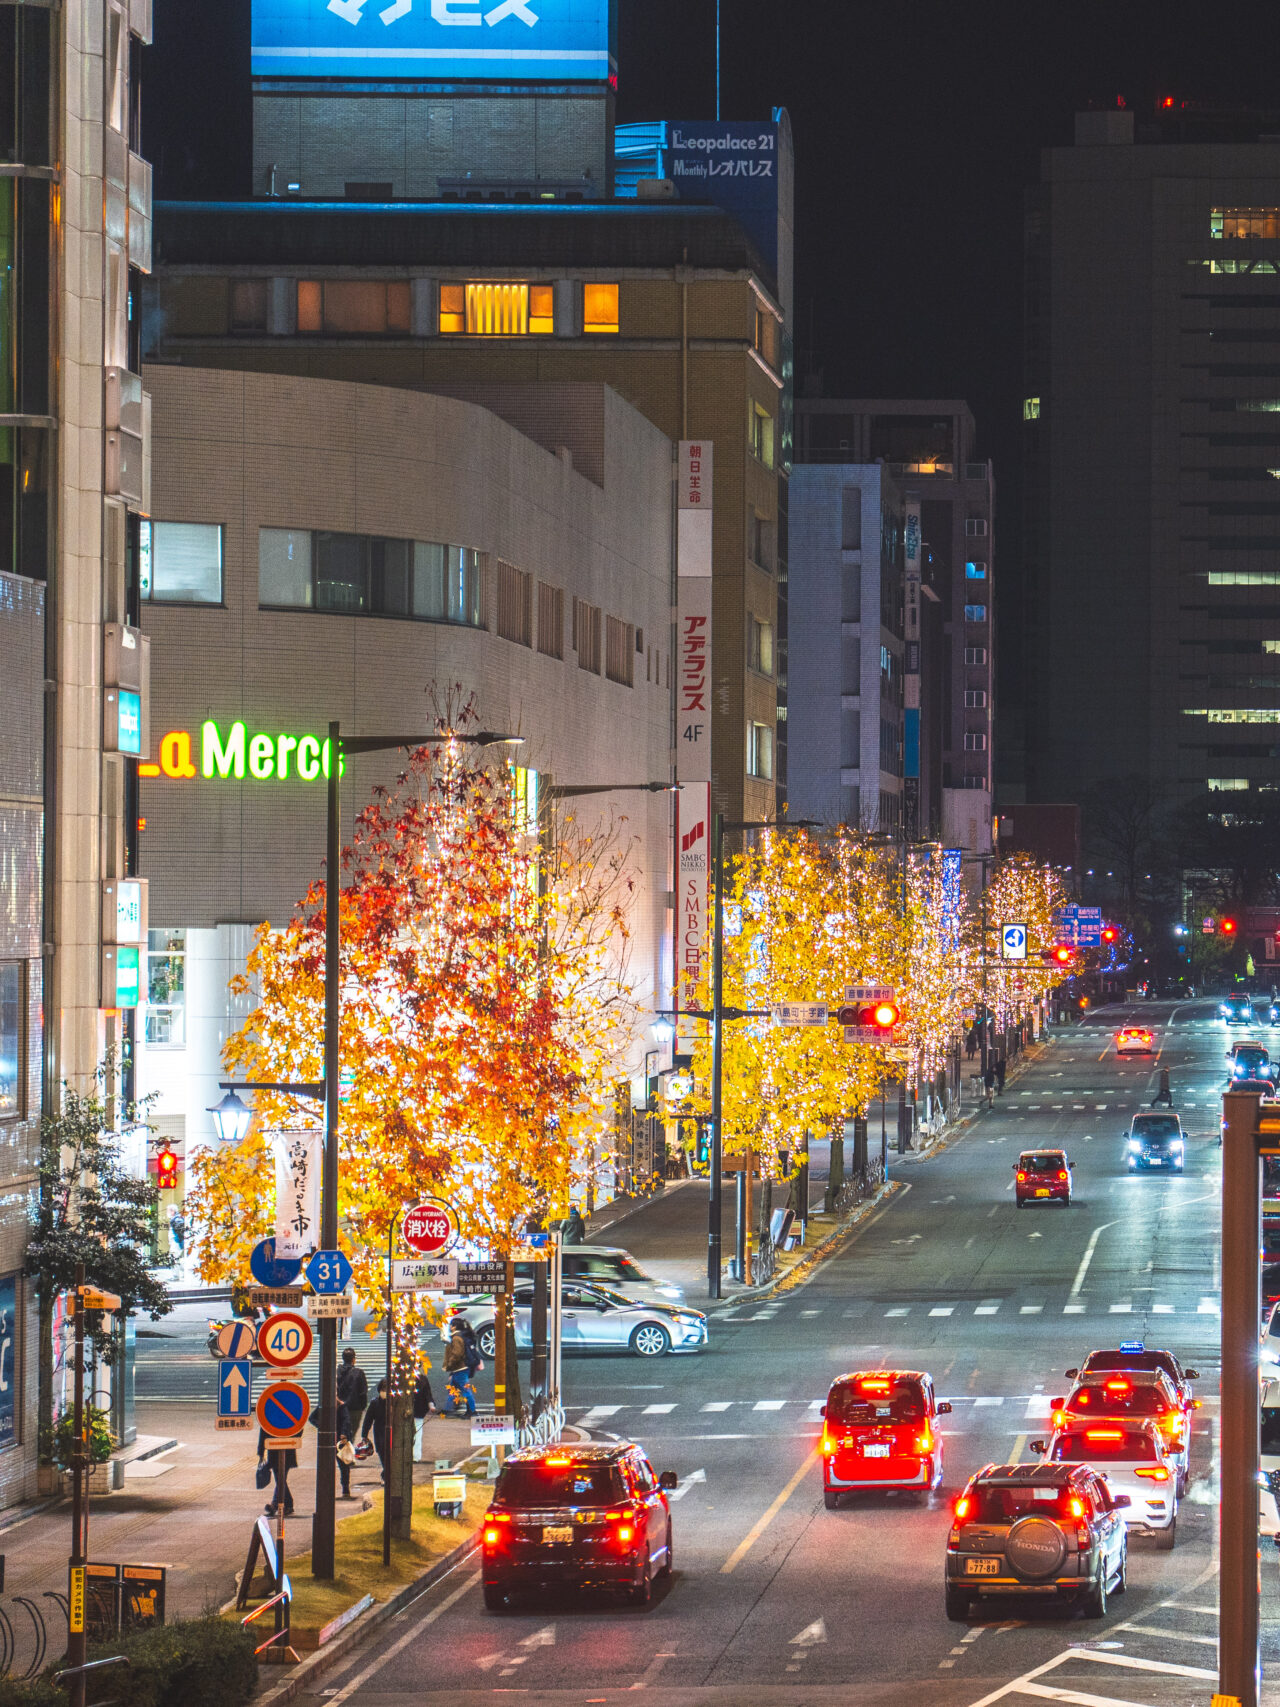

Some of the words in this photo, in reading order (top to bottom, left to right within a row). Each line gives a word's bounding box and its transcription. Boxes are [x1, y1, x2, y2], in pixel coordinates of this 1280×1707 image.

[672, 130, 757, 154] Leopalace
[758, 135, 774, 149] 21
[673, 160, 707, 179] Monthly
[708, 160, 773, 176] レオパレス
[689, 444, 702, 504] 朝日生命
[681, 616, 707, 711] アデランス
[683, 725, 704, 742] 4F
[681, 853, 706, 861] SMBC
[775, 1007, 825, 1017] 八島町十字路
[288, 1141, 311, 1237] 高崎だるま市
[407, 1219, 447, 1238] 消火栓
[318, 1262, 341, 1280] 31
[402, 1264, 449, 1277] 広告募集
[270, 1328, 300, 1352] 40
[1016, 1541, 1056, 1553] HONDA
[974, 1565, 996, 1573] 77-88
